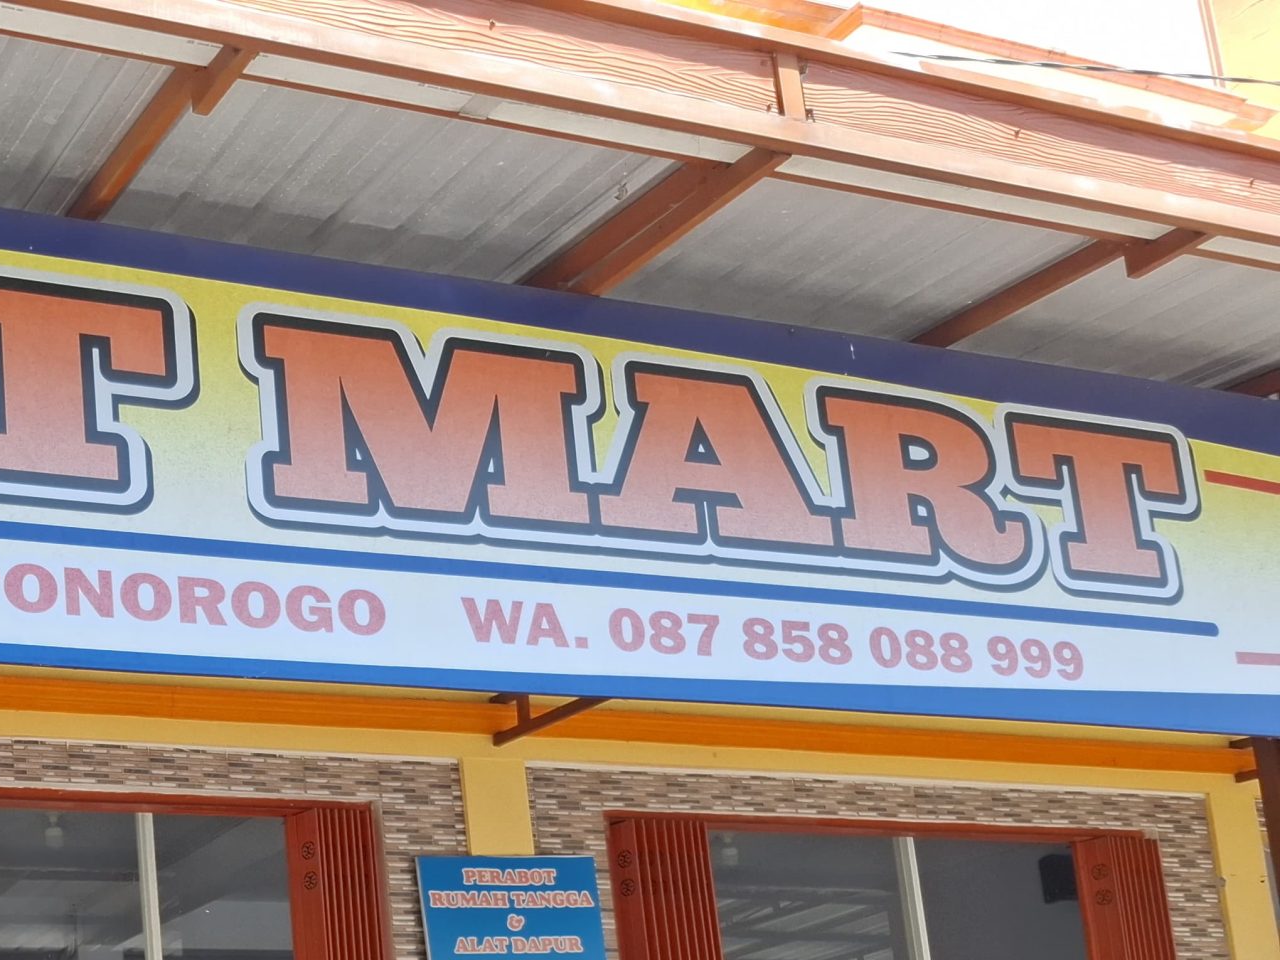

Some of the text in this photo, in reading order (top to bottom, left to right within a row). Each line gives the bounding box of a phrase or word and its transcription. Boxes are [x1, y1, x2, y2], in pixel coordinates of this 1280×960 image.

[258, 320, 1188, 584] MART
[460, 596, 589, 649] WA.
[608, 607, 720, 657] 087
[742, 616, 853, 666] 858
[869, 626, 974, 675] 088
[990, 635, 1085, 682] 999
[463, 869, 556, 887] PERABOT
[429, 891, 595, 908] RUMAH TANGGA
[507, 914, 525, 931] &
[454, 936, 583, 954] ALAT DAPUR
